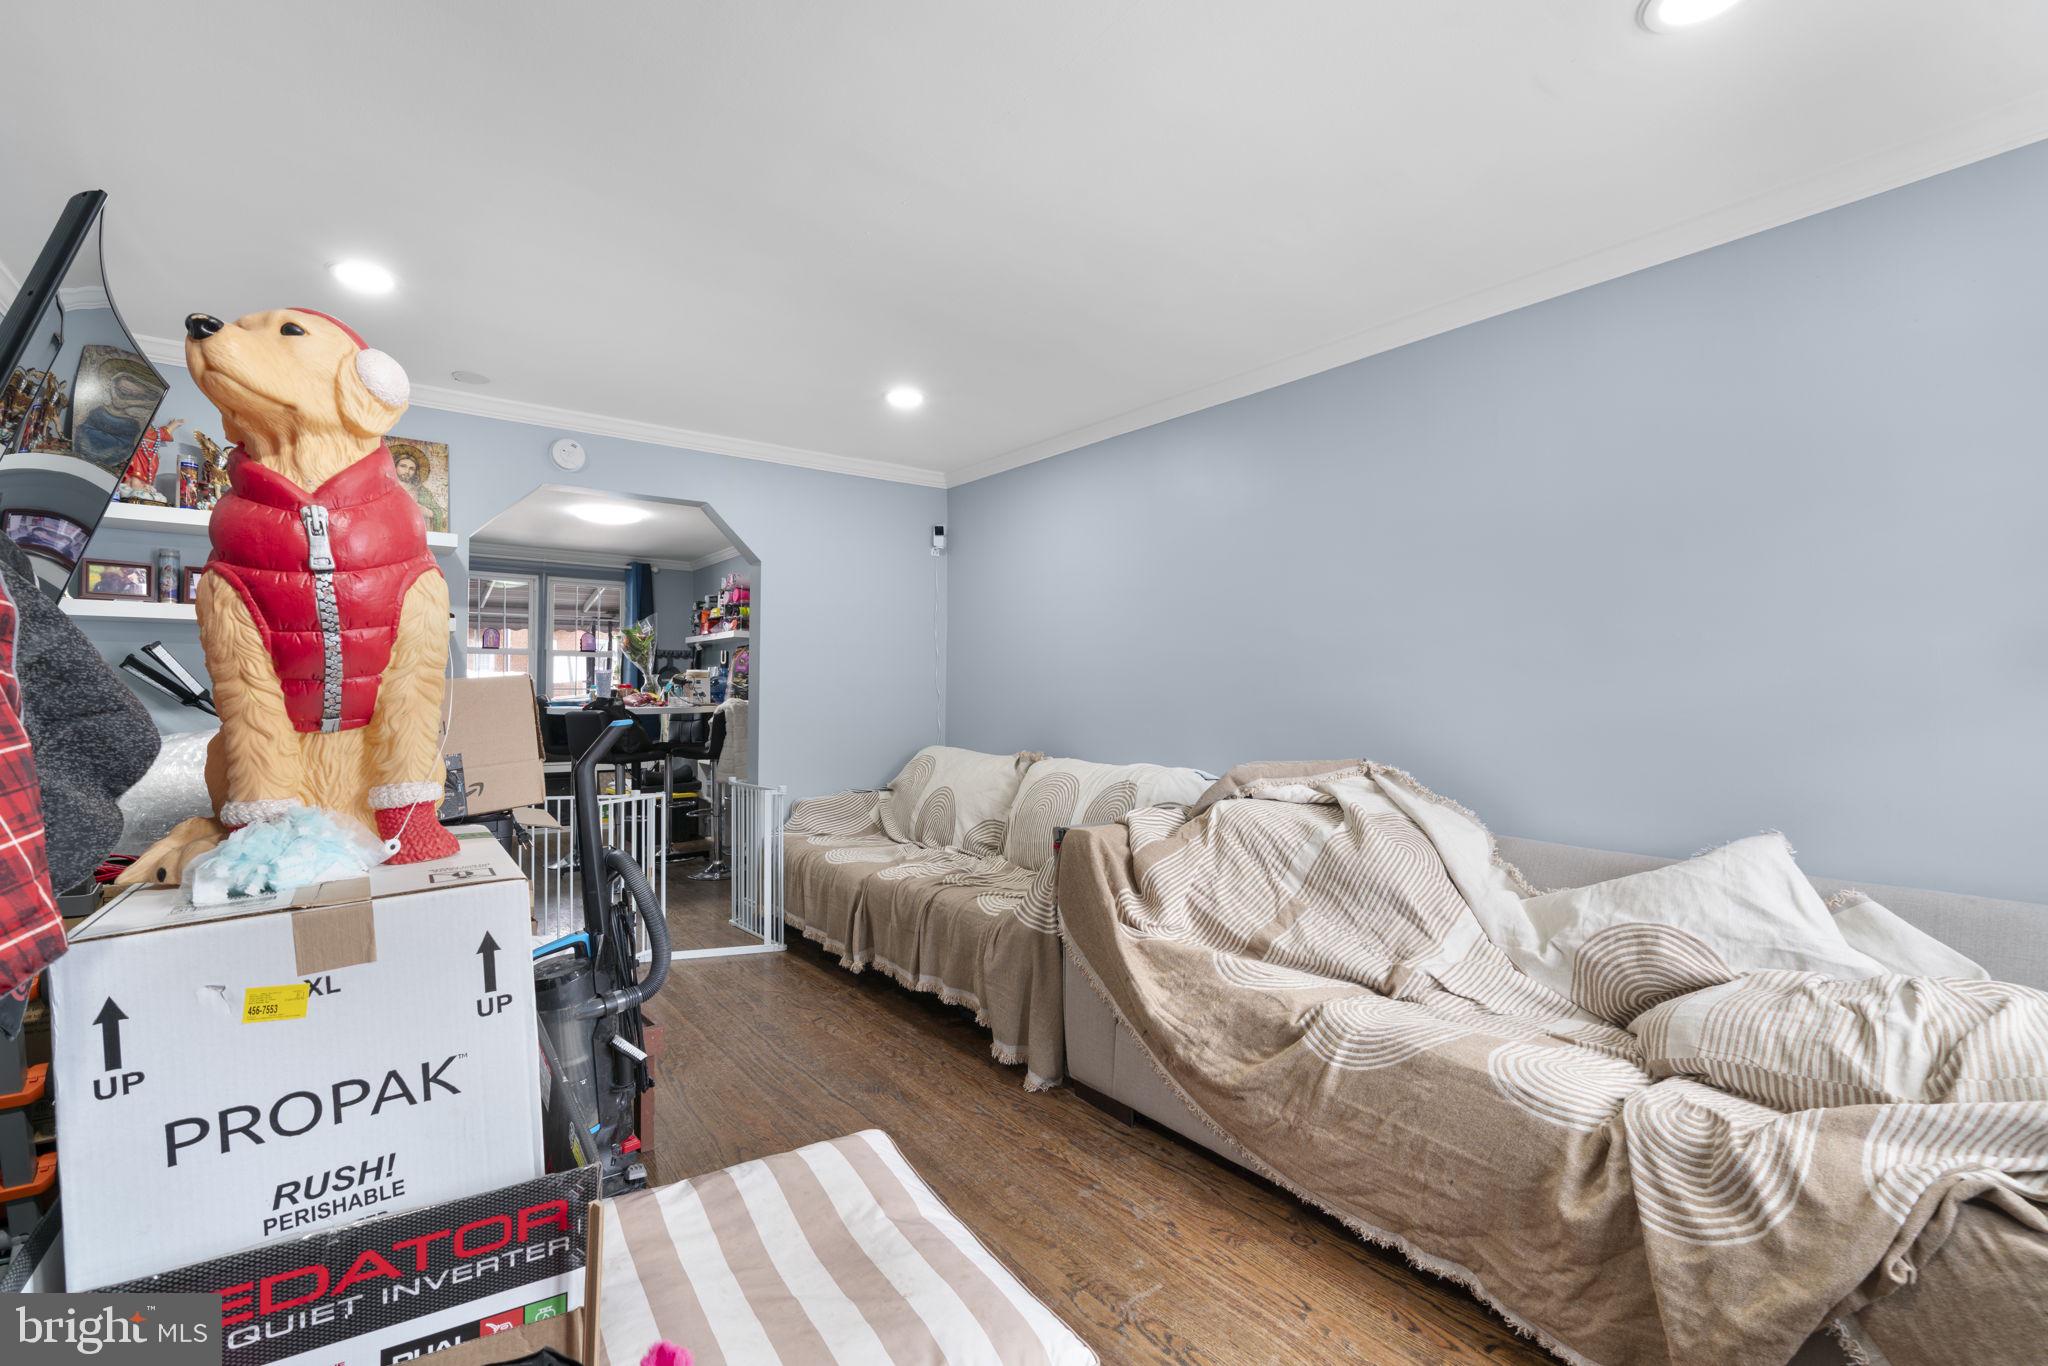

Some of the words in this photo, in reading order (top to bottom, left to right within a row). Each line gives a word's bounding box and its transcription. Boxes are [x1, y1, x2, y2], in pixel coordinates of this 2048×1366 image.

[476, 993, 513, 1017] UP
[93, 1071, 145, 1100] UP
[164, 1055, 462, 1168] PROPAK
[263, 1179, 405, 1236] PERISHABLE
[272, 1152, 396, 1211] RUSH!
[227, 1294, 364, 1350] QUIET
[382, 1236, 570, 1304] INVERTER
